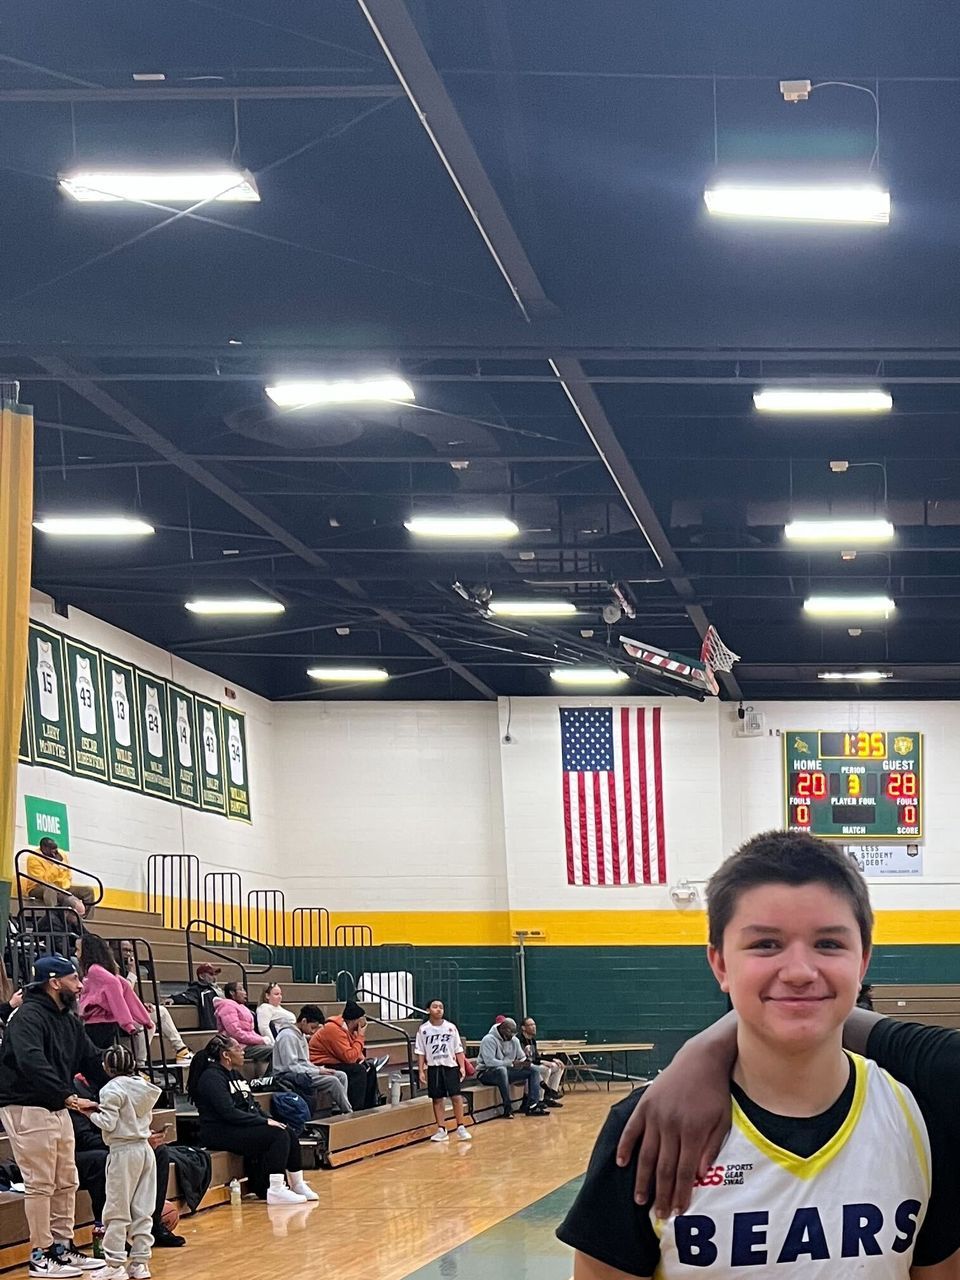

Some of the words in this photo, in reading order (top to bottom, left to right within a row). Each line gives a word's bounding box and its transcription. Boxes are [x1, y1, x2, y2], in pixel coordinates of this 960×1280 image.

[42, 672, 52, 694] 15
[80, 688, 92, 708] 43
[116, 700, 125, 720] 13
[148, 714, 158, 734] 24
[843, 731, 885, 757] 1:35
[794, 760, 822, 770] HOME
[882, 760, 914, 770] GUEST
[841, 766, 866, 774] PERIOD
[797, 773, 826, 796] 20
[848, 774, 861, 795] 3
[888, 773, 916, 796] 28
[36, 814, 61, 834] HOME
[797, 806, 808, 824] 0
[904, 806, 916, 824] 0
[842, 826, 866, 834] MATCH
[692, 1165, 724, 1188] GS
[722, 1178, 744, 1186] SWAG
[674, 1198, 922, 1268] BEARS
